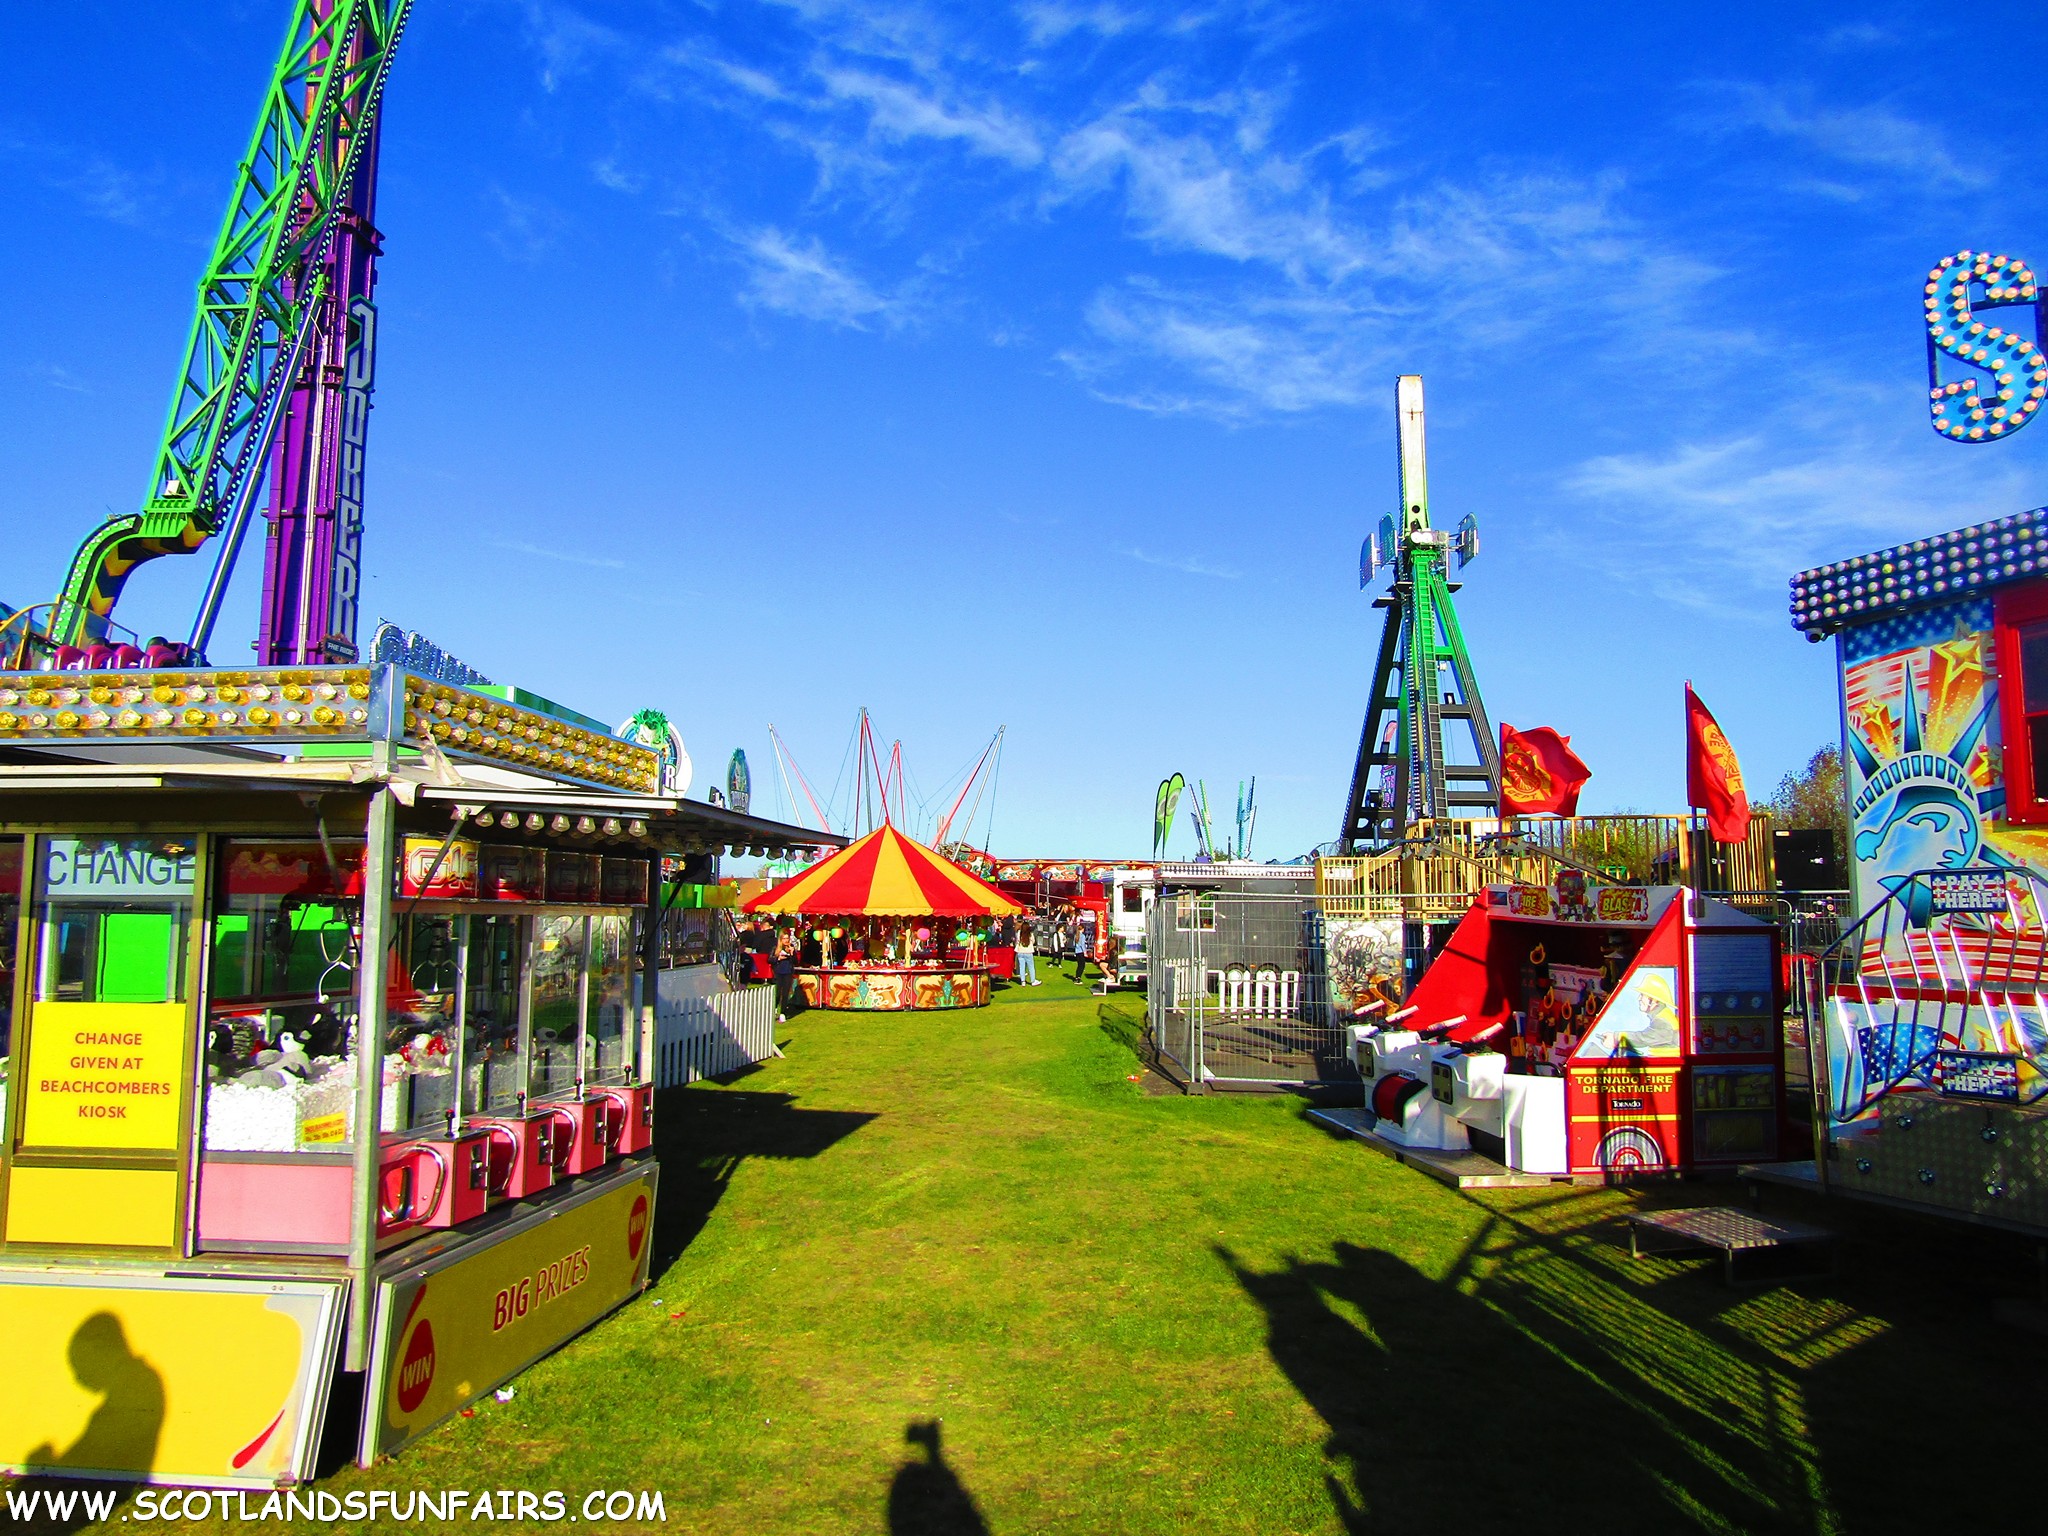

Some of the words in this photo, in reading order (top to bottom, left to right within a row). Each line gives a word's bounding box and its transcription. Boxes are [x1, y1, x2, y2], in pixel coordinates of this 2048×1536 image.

[48, 850, 195, 886] CHANGE
[1945, 874, 1989, 891] PAY
[1945, 892, 1993, 908] HERE
[74, 1032, 142, 1046] CHANGE
[70, 1056, 118, 1069] GIVEN
[122, 1057, 143, 1069] AT
[1955, 1057, 1998, 1077] PAY
[40, 1080, 170, 1095] BEACHCOMBERS
[1575, 1076, 1639, 1084] TORNADO
[1644, 1075, 1673, 1084] FIRE
[1954, 1075, 2004, 1096] HERE
[1582, 1084, 1672, 1094] DEPARTMENT
[78, 1105, 126, 1119] KIOSK
[631, 1210, 646, 1235] WIN
[493, 1276, 531, 1333] BIG
[534, 1244, 591, 1310] PRIZES
[403, 1352, 432, 1392] WIN
